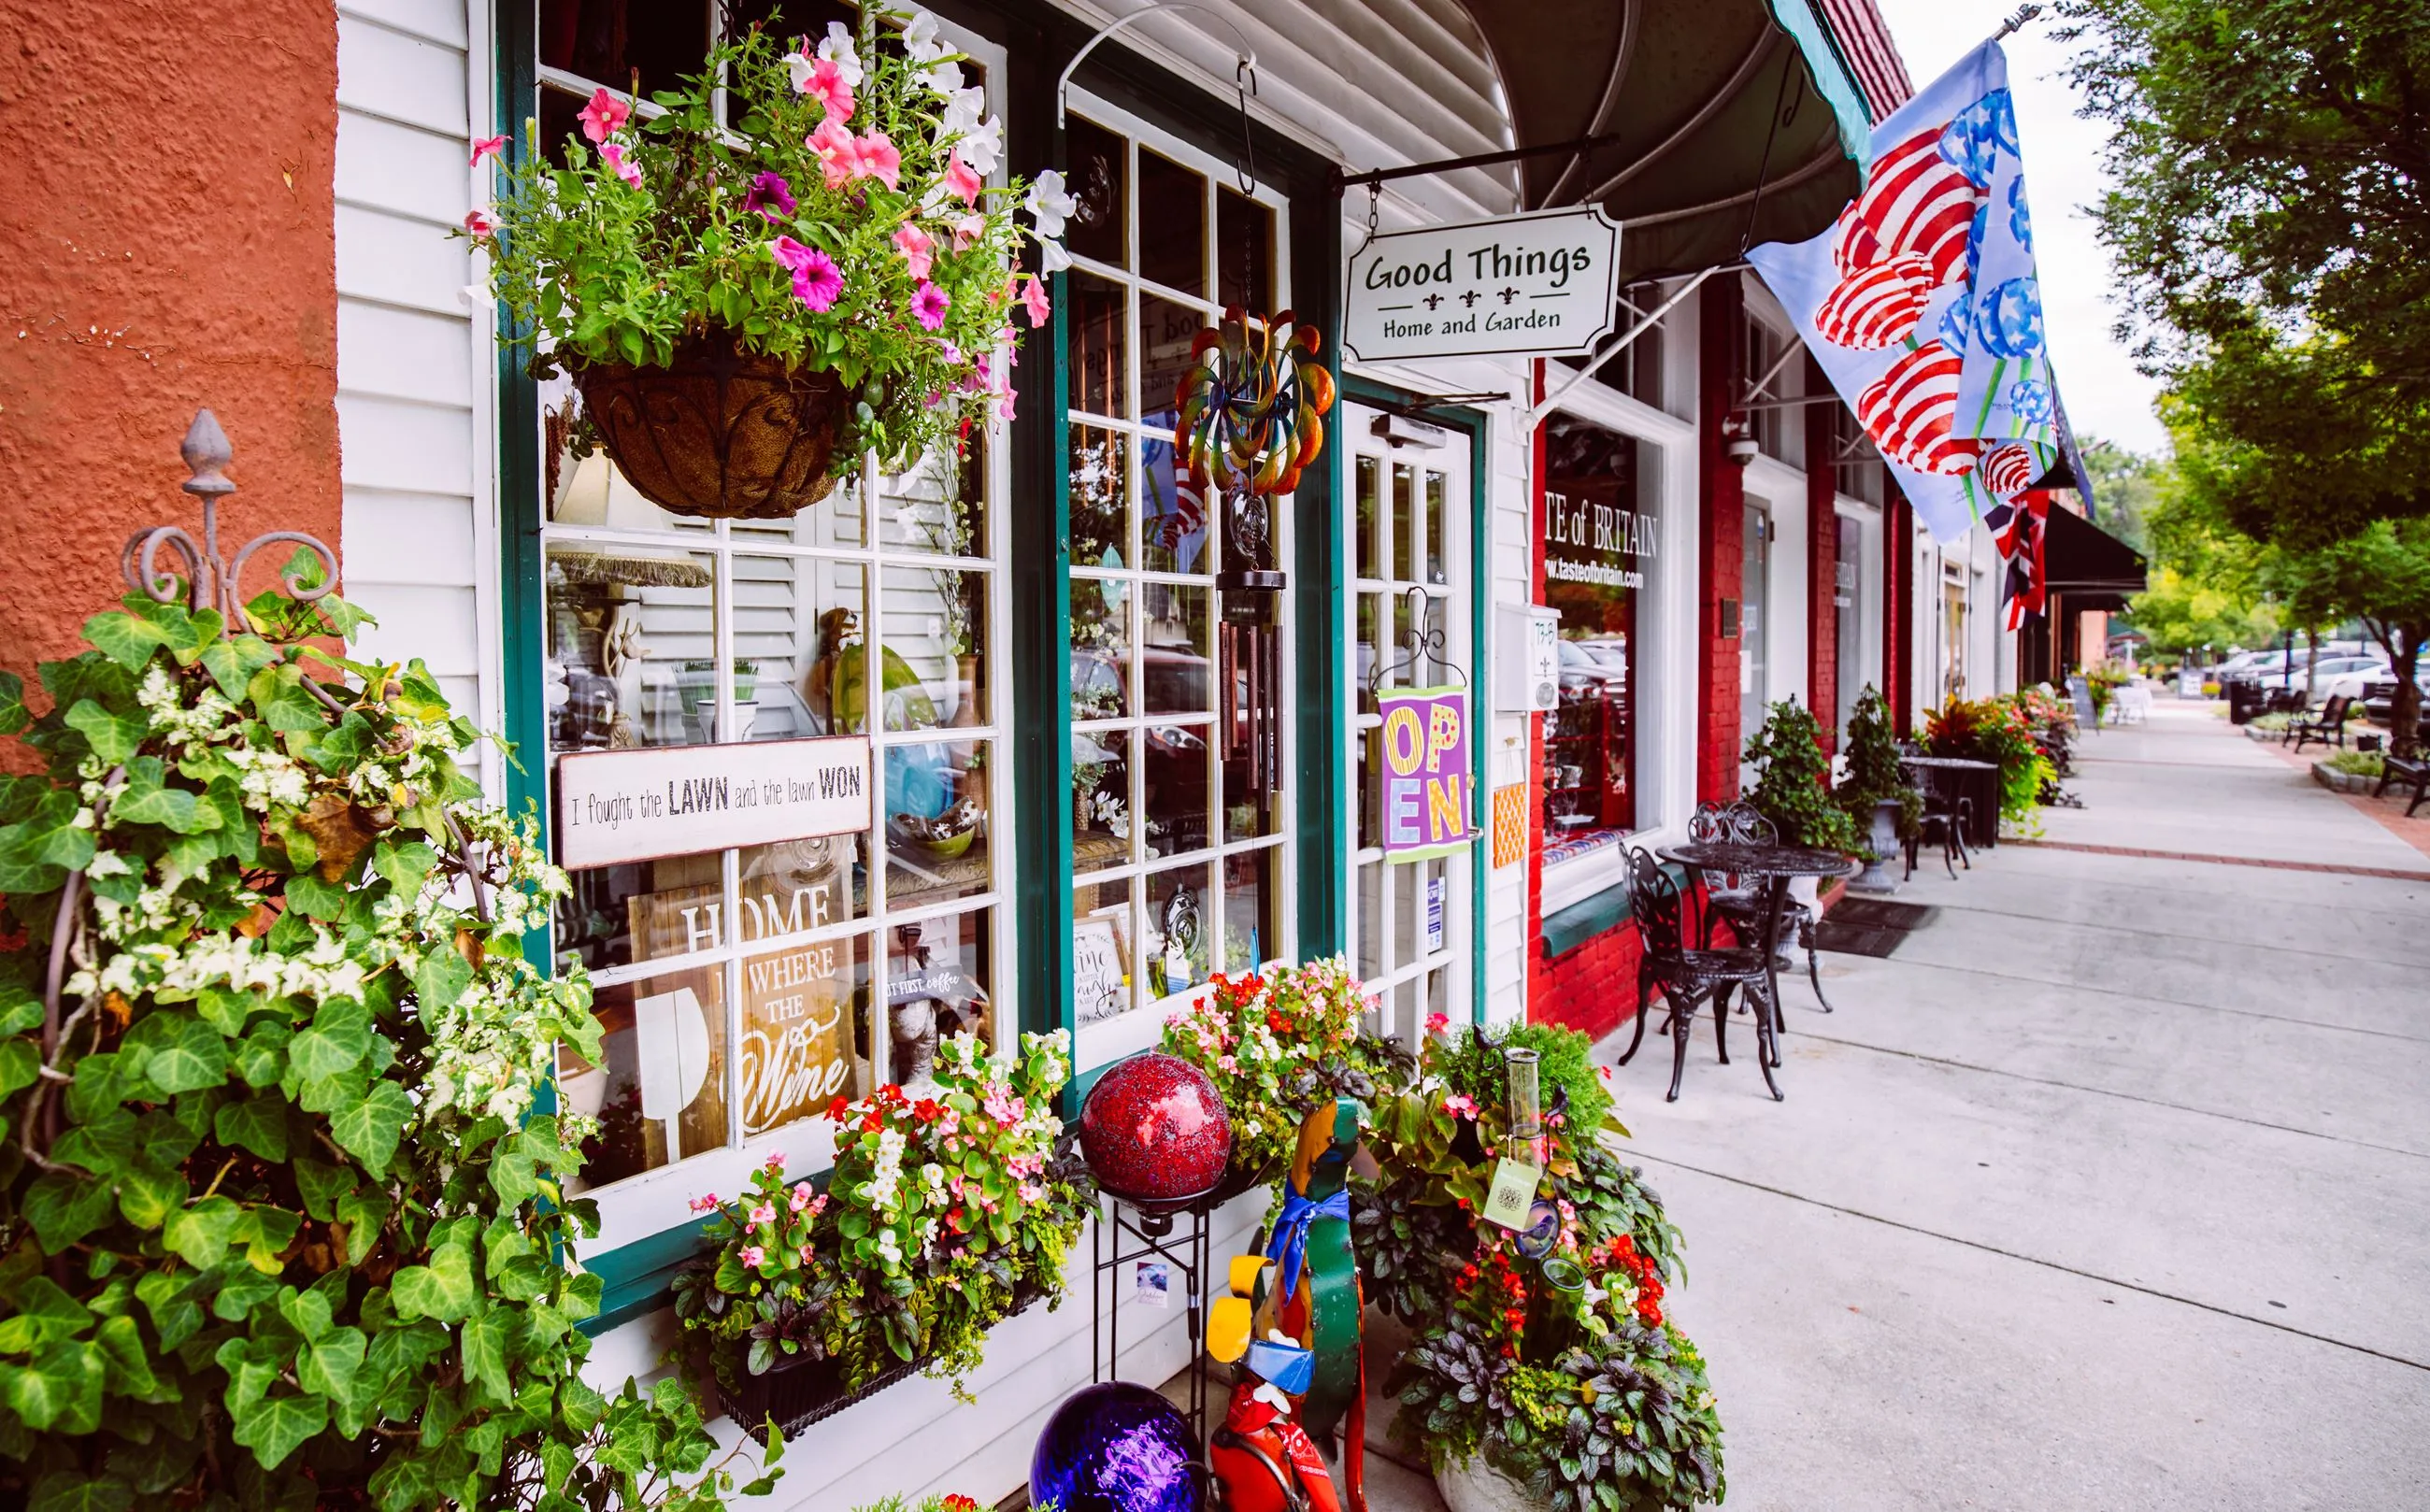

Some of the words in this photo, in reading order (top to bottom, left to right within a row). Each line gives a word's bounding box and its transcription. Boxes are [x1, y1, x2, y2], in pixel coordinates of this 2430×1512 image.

[1365, 248, 1452, 291] Good
[1467, 243, 1592, 289] Things
[1384, 319, 1434, 338] Home
[1442, 313, 1477, 335] and
[1485, 308, 1561, 332] Garden
[1571, 498, 1588, 547] of
[1594, 503, 1658, 558] BRITAIN
[572, 798, 579, 826] I
[588, 792, 633, 831] fought
[640, 789, 662, 819] the
[669, 777, 728, 816] LAWN
[735, 779, 758, 809] and
[764, 778, 782, 806] the
[788, 777, 815, 804] lawn
[819, 765, 861, 800] WON
[747, 947, 836, 995] WHERE
[926, 971, 960, 993] coffee
[765, 993, 806, 1023] THE
[719, 1005, 850, 1134] Wine
